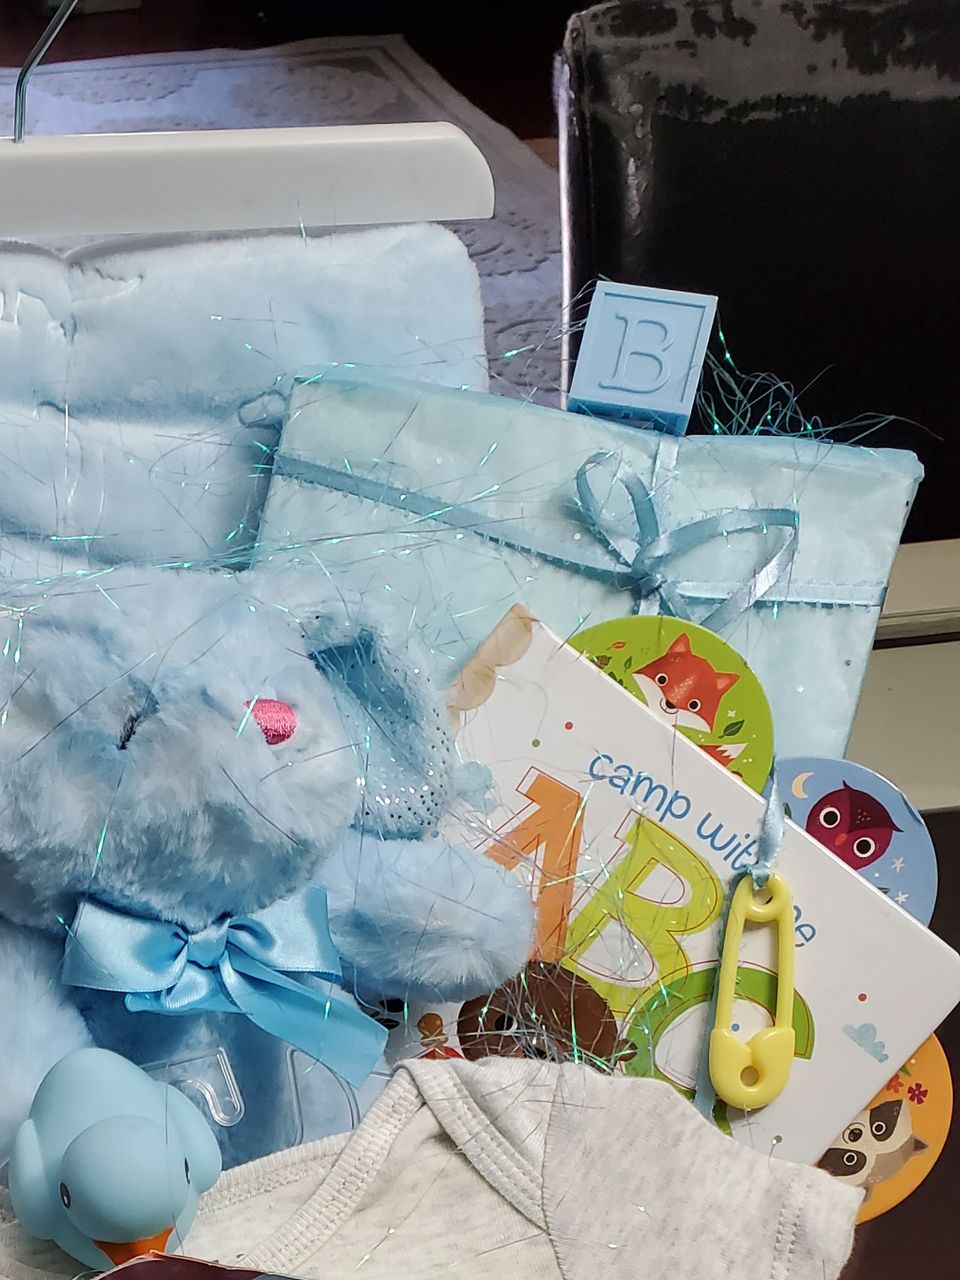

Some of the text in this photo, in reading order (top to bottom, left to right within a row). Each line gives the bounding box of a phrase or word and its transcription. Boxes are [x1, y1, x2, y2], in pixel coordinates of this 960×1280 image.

[598, 312, 677, 394] B
[589, 754, 692, 822] camp
[696, 811, 759, 871] wit
